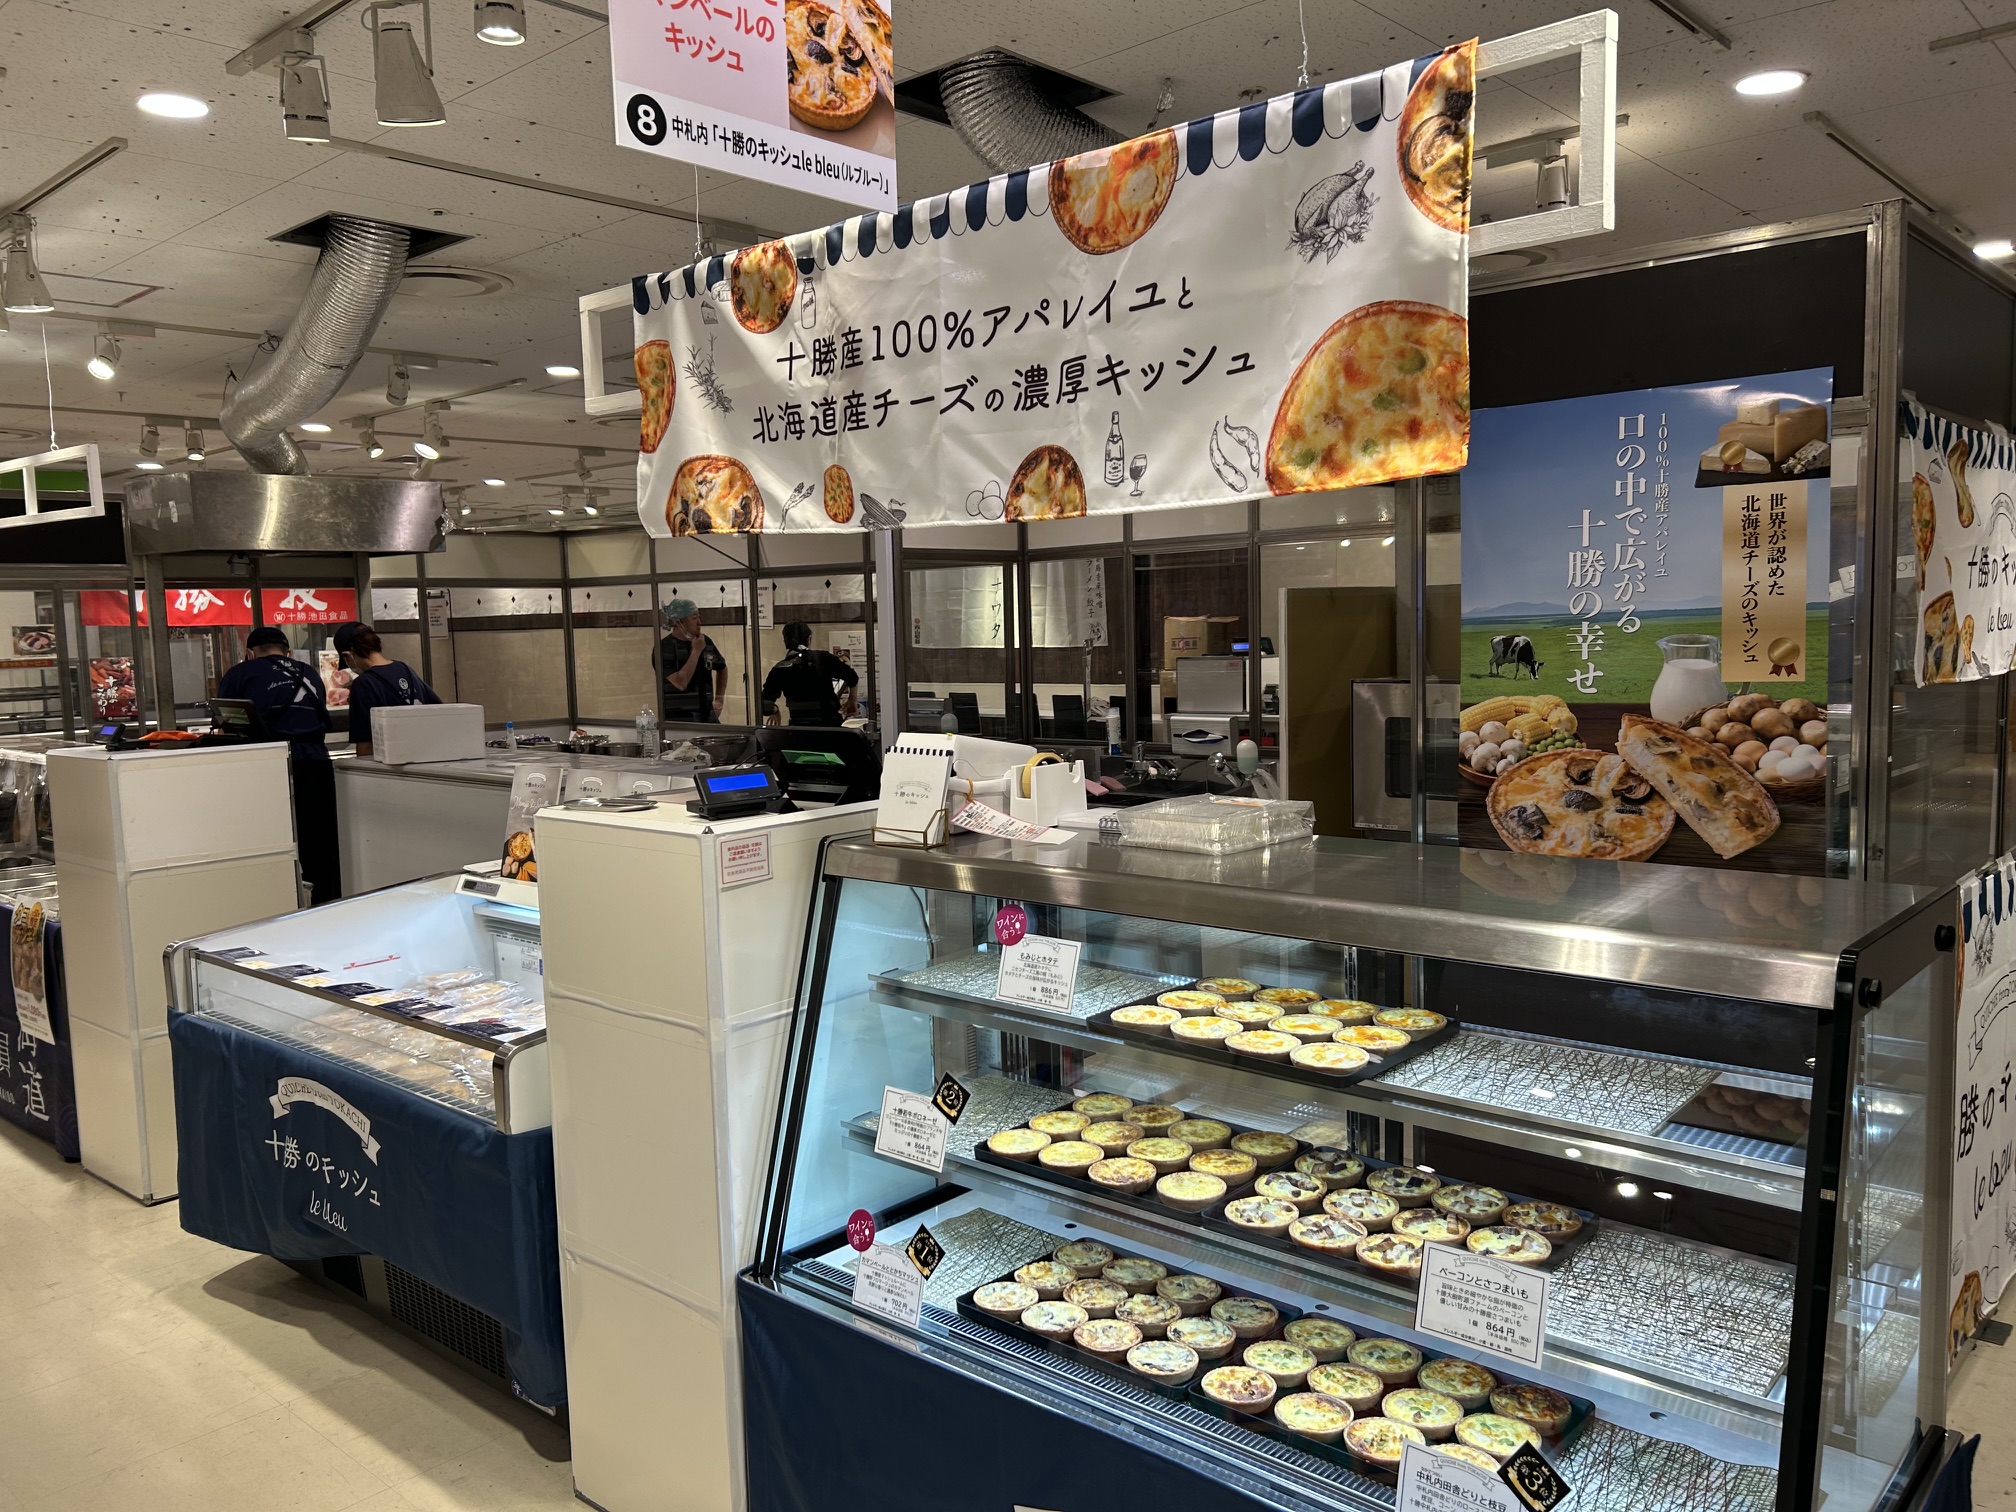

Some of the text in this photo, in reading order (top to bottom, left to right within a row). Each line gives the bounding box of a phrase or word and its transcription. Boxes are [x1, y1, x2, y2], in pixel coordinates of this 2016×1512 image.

[665, 22, 744, 72] キッシュ
[636, 104, 656, 136] 8
[777, 276, 1195, 381] 十勝産100%アパレイユと
[753, 345, 1256, 444] 北海道産チーズの濃厚キッシュ
[1653, 412, 1671, 578] 100%十勝産アパレイユ
[1611, 413, 1648, 634] 口の中で広がる
[1767, 493, 1788, 596] 世界が認めた
[1741, 495, 1761, 663] 北海道チーズのキッシュ
[287, 610, 348, 621] 十勝池田食品
[1566, 509, 1607, 694] 十勝の幸せ
[997, 913, 1024, 929] ワインに
[1001, 927, 1015, 939] 合う
[1020, 952, 1058, 965] もみじとホタテ
[327, 1095, 367, 1133] TOKACHI
[265, 1129, 381, 1206] 十勝のキッシュ
[849, 1221, 873, 1234] ワインに
[853, 1233, 865, 1245] 合う
[1440, 1267, 1528, 1299] ベーコンとさつまいも
[1416, 1470, 1507, 1512] 中札内田舎どりと枝豆
